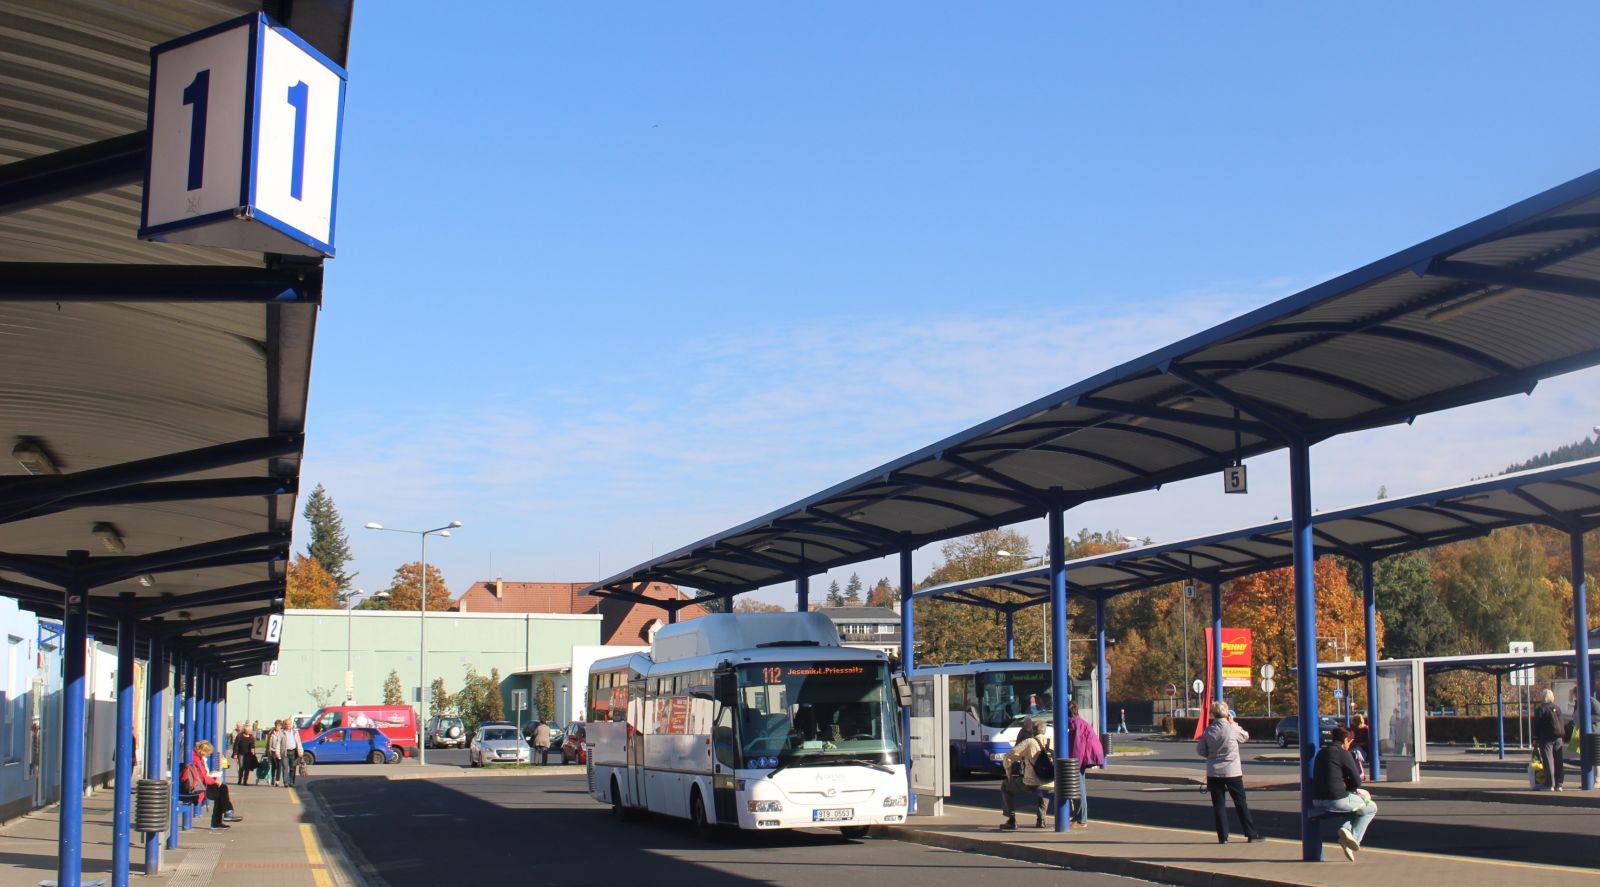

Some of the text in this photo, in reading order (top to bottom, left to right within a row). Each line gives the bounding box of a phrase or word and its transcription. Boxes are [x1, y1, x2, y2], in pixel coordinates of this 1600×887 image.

[183, 69, 210, 191] 1
[287, 80, 309, 201] 1
[1231, 471, 1240, 487] 5
[256, 617, 263, 635] 2
[270, 620, 277, 637] 2
[1221, 642, 1248, 651] PENNY
[762, 667, 782, 684] 112
